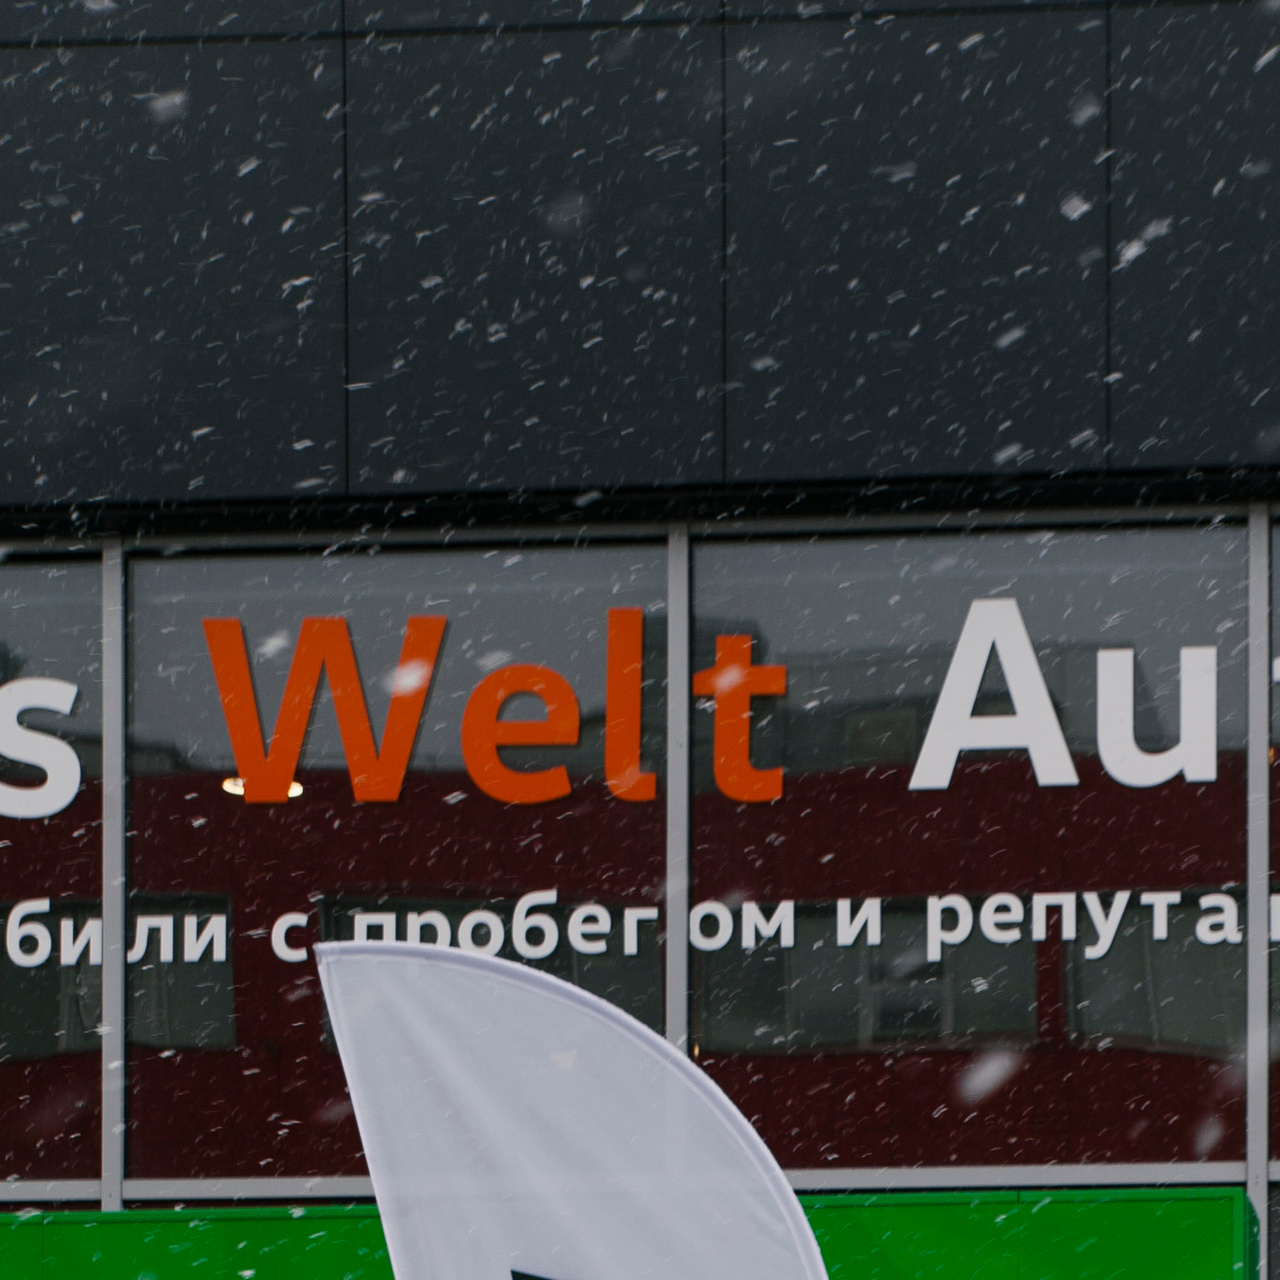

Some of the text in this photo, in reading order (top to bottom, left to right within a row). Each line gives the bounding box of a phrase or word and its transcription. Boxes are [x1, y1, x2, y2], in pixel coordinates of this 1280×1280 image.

[202, 607, 788, 803] Welt
[5, 897, 228, 967] били
[271, 912, 309, 962] с
[837, 897, 881, 944] и
